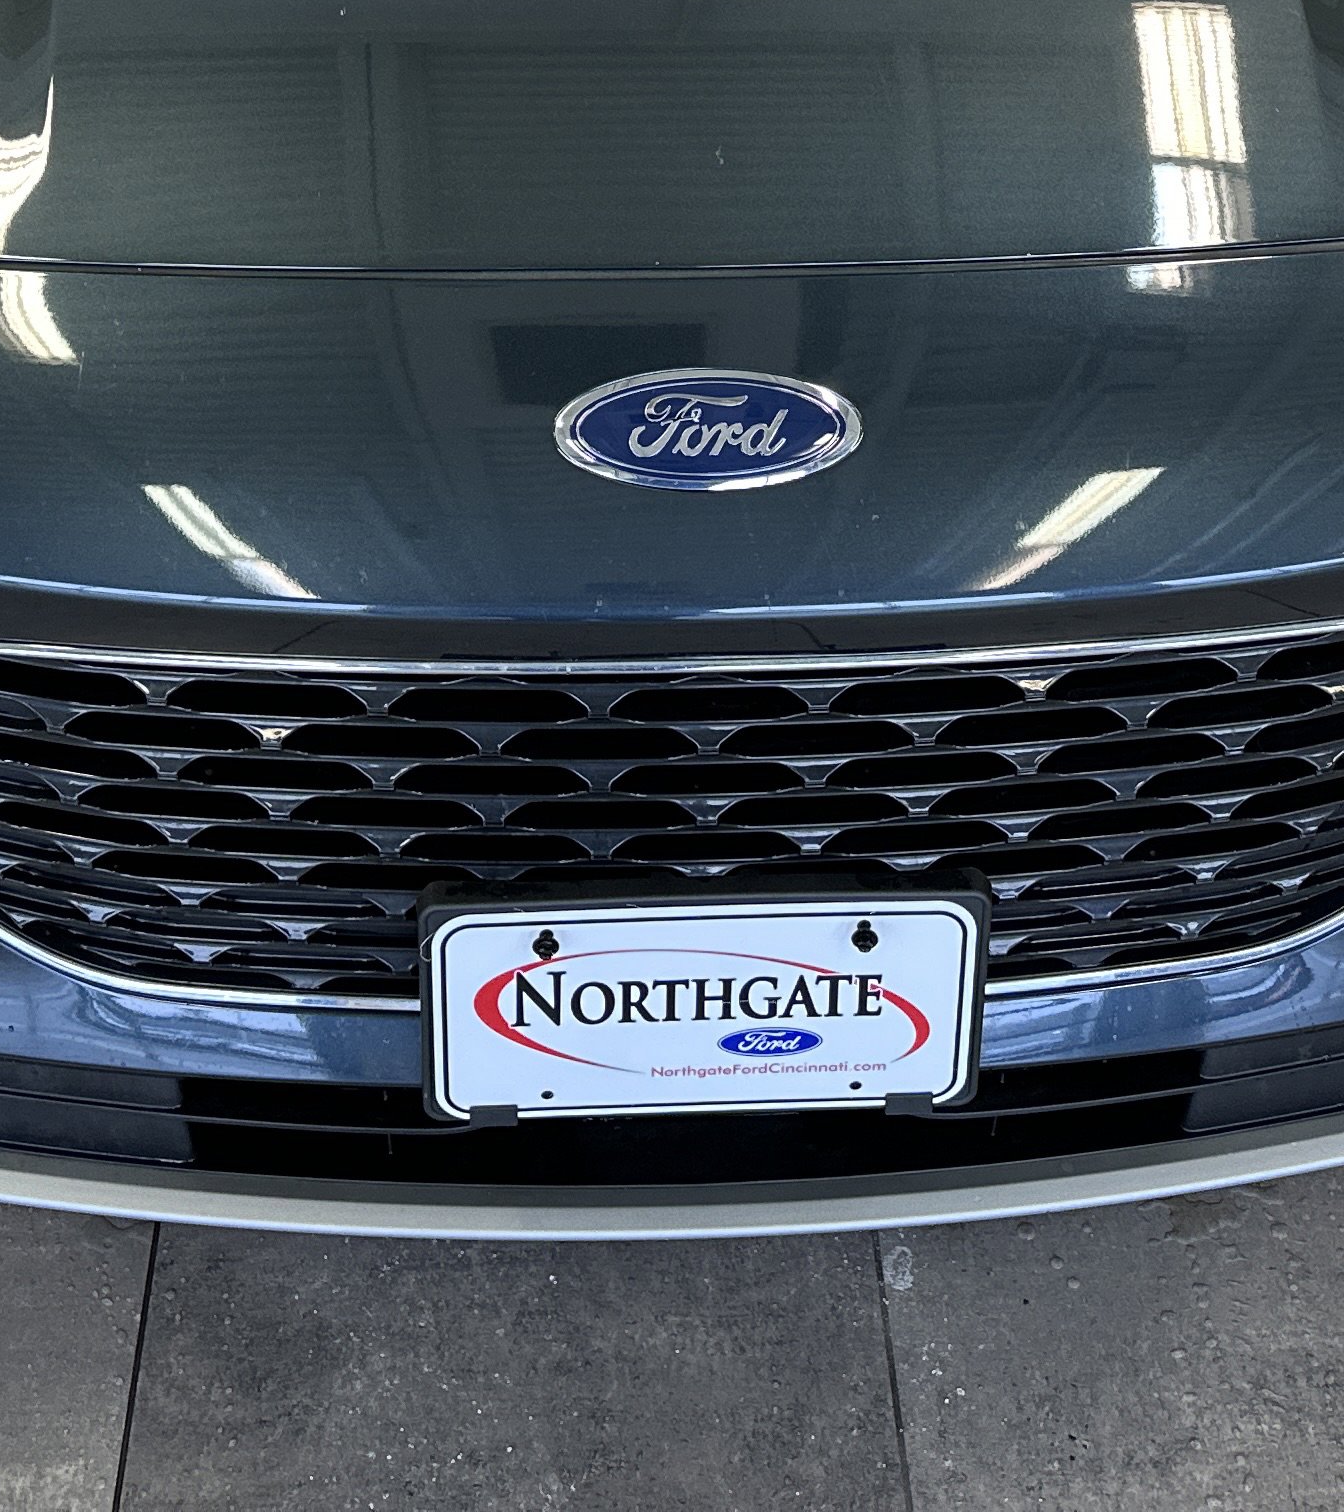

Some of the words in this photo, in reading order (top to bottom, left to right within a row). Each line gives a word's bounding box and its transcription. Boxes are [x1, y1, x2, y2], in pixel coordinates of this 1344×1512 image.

[628, 393, 789, 458] Ford
[511, 970, 884, 1027] NORTHGATE
[737, 1031, 802, 1052] Ford
[651, 1061, 887, 1079] NorthgateFordCincinnati.com
